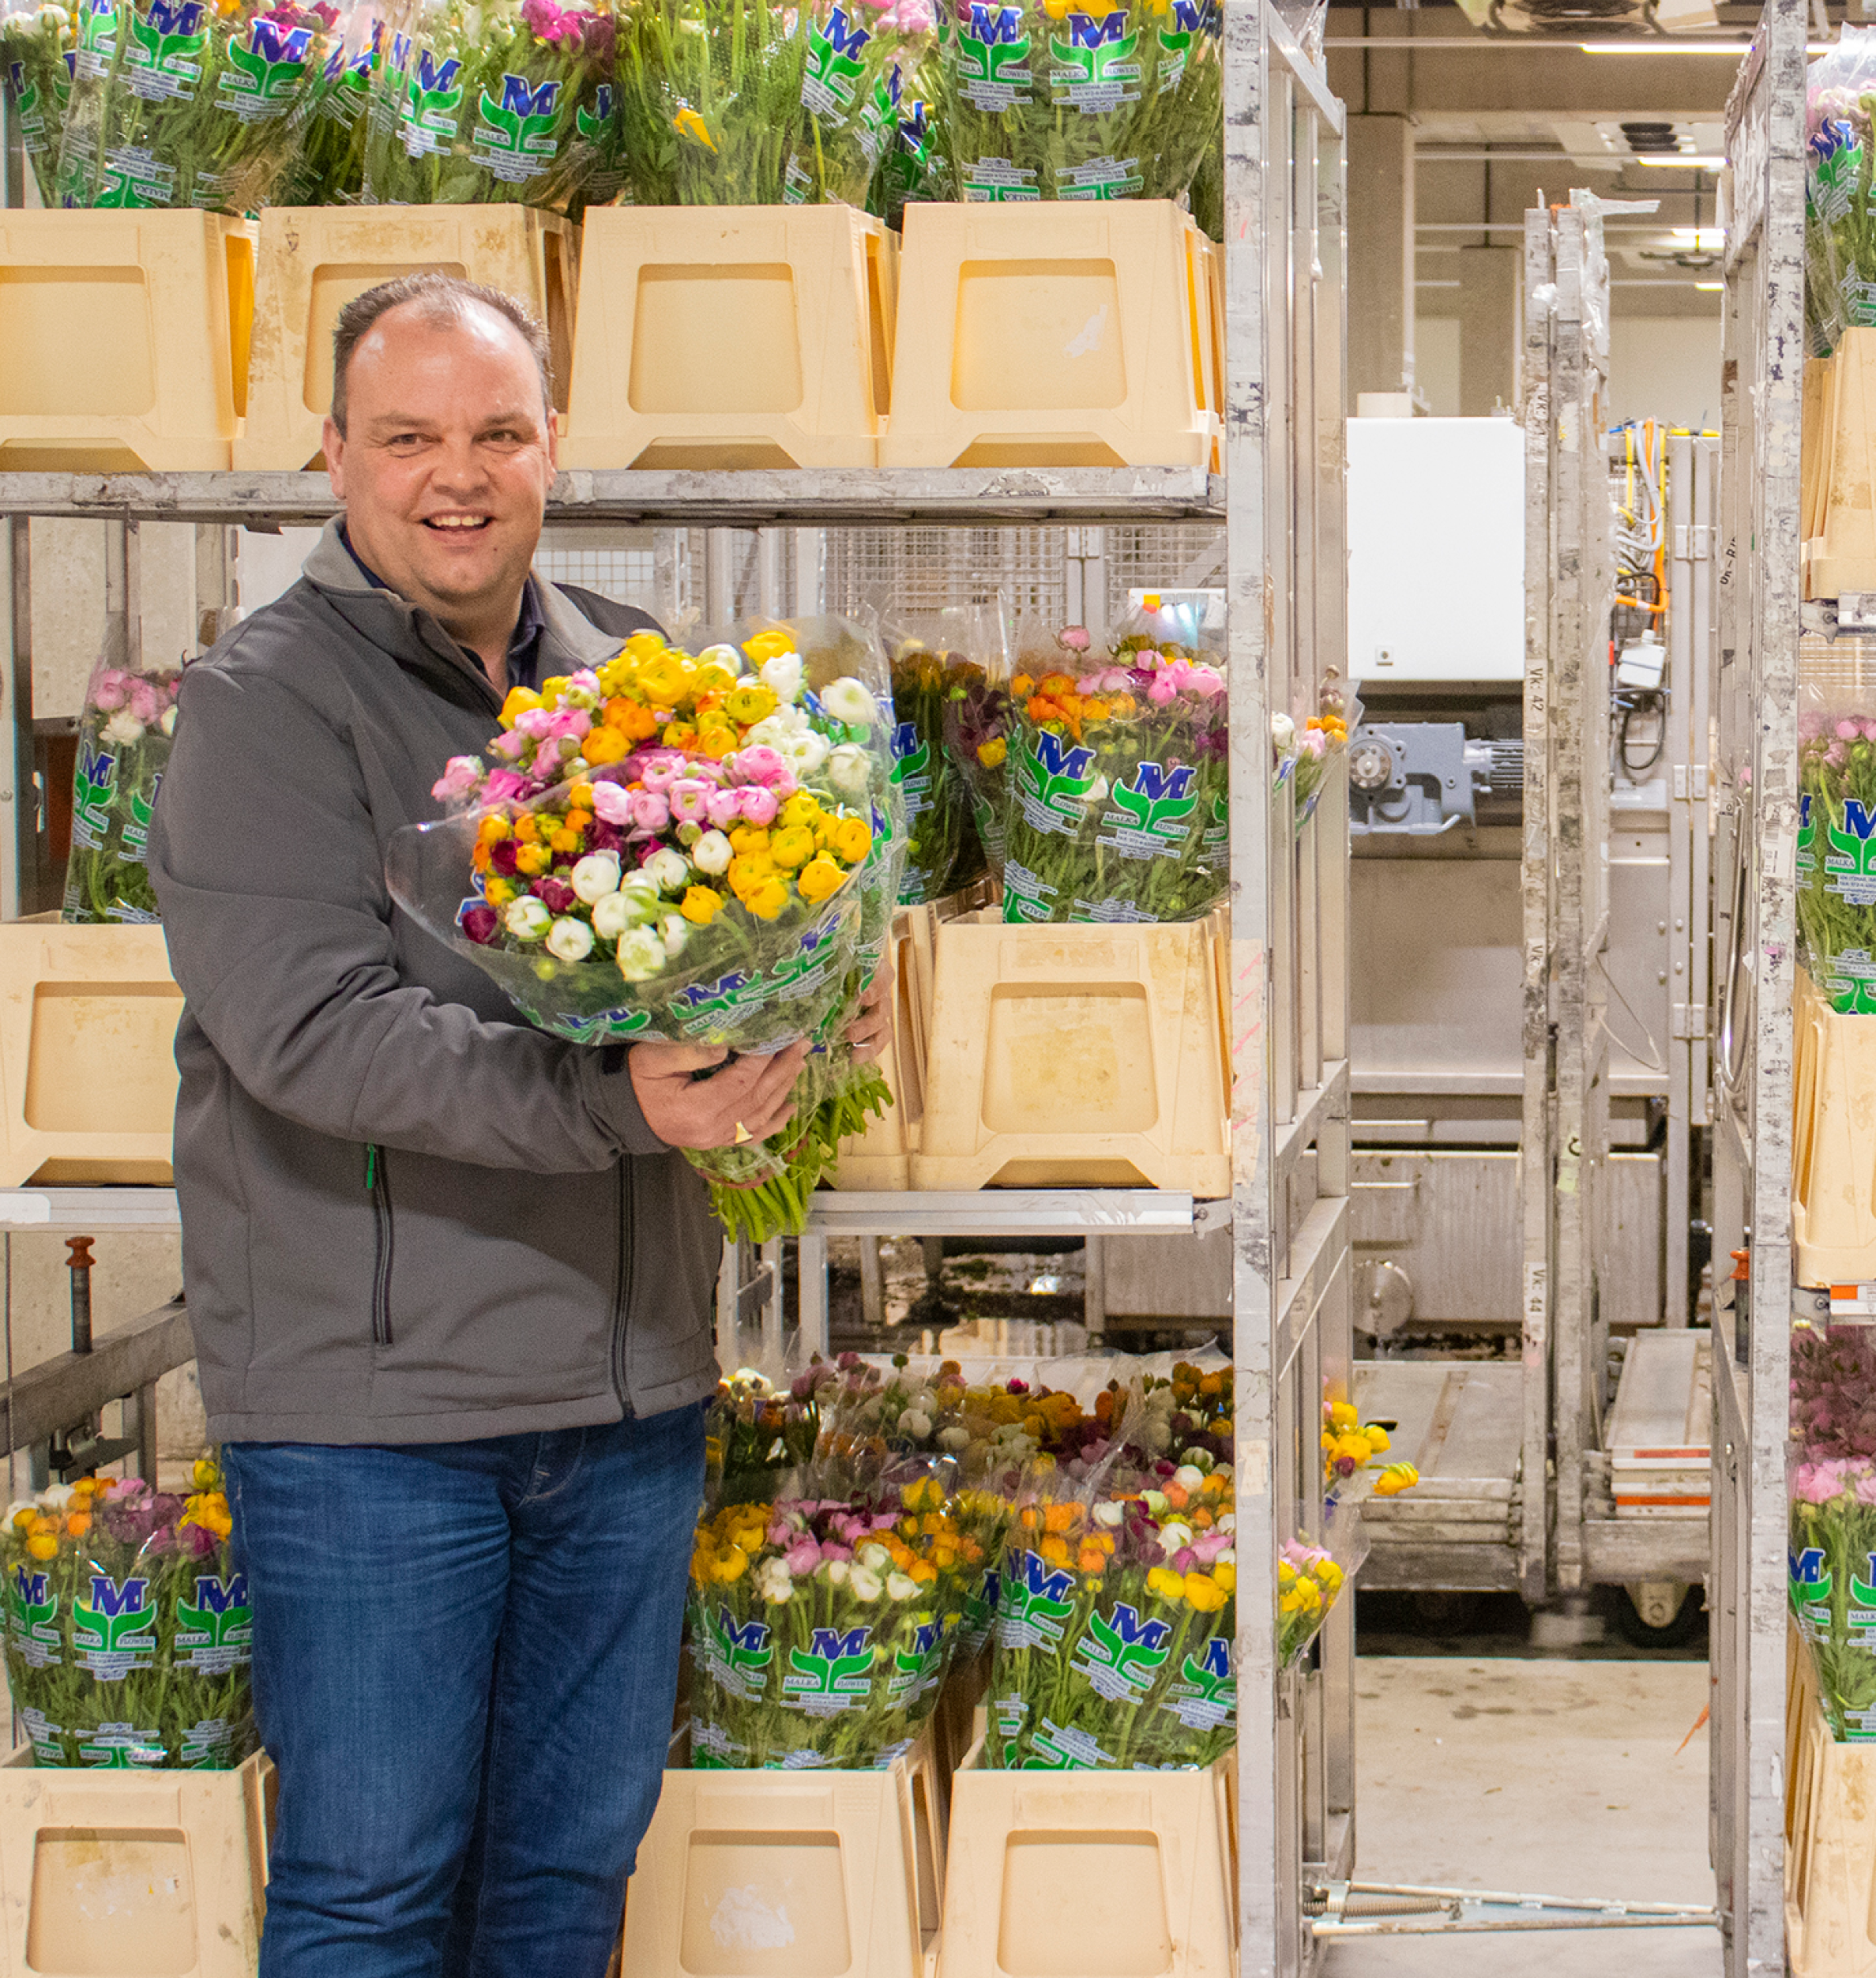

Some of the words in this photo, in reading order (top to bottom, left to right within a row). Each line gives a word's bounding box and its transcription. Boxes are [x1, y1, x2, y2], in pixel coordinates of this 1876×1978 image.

[147, 0, 205, 36] M
[824, 6, 870, 62] M
[971, 4, 1021, 46] M
[1067, 11, 1128, 48] M
[251, 20, 313, 63] M
[223, 74, 257, 88] MALKA
[419, 49, 462, 92] M
[502, 75, 561, 118] M
[476, 130, 509, 145] MALKA
[1530, 667, 1543, 690] Vk:
[1530, 695, 1544, 712] 42
[83, 743, 115, 788] M
[1036, 731, 1096, 780] M
[1133, 760, 1196, 801] M
[1106, 814, 1138, 825] MALKA
[1827, 857, 1855, 867] MALKA
[19, 1565, 48, 1606] M
[197, 1576, 250, 1614] M
[1023, 1549, 1074, 1603] M
[92, 1576, 148, 1617] M
[119, 1637, 154, 1645] FLOWERS
[176, 1634, 210, 1644] MALKA
[718, 1604, 769, 1652] M
[811, 1627, 870, 1660] M
[1110, 1604, 1173, 1651] M
[1081, 1639, 1111, 1659] MALKA
